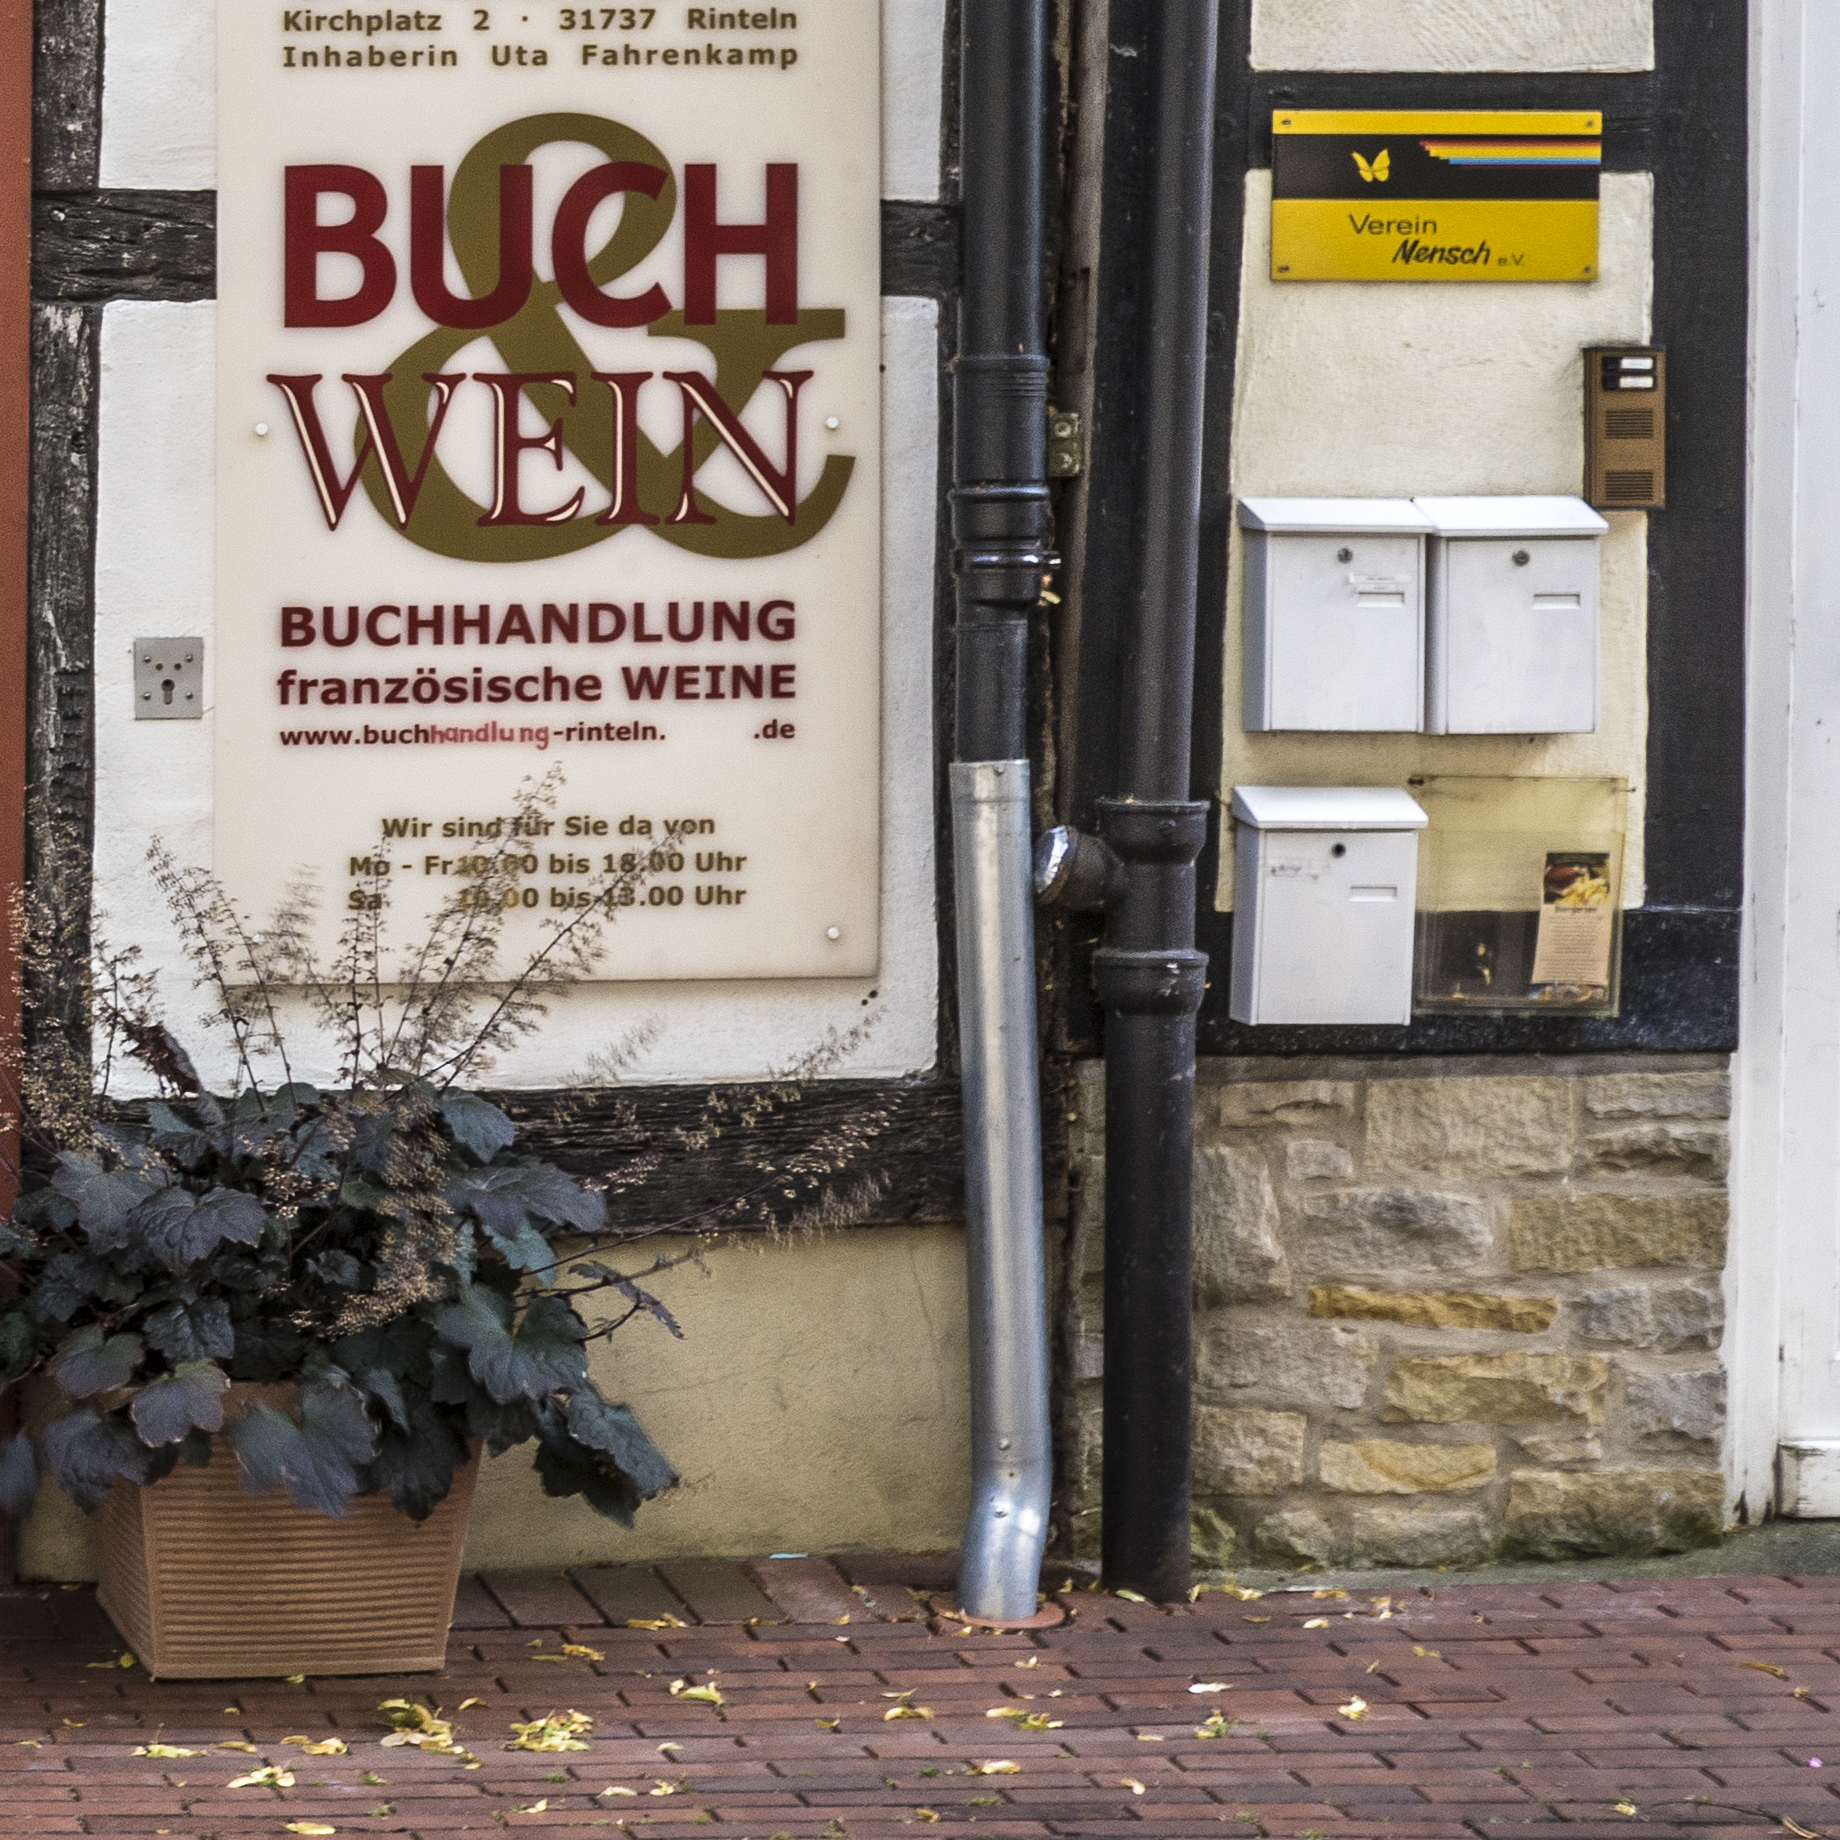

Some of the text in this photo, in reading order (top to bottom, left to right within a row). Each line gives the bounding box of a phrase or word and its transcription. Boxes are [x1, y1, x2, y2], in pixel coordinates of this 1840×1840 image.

[283, 7, 798, 36] Kirchplatz 2 31737 Rinteln
[283, 43, 798, 70] Inhaberin Uta Fahrenkamp
[1348, 214, 1437, 236] Verein
[284, 163, 799, 329] BUCH
[1391, 240, 1491, 266] Mensch
[266, 370, 814, 531] WEIN
[281, 600, 796, 647] BUCHHANDLUNG
[277, 664, 797, 705] französische WEINE
[381, 815, 716, 838] Wir sind für Sie da von
[349, 856, 391, 877] Mo
[424, 855, 453, 876] Fr
[549, 853, 590, 875] bis
[695, 851, 747, 872] Uhr
[348, 889, 383, 910] Sa
[459, 887, 539, 909] 1000
[550, 887, 590, 908] bis
[695, 885, 746, 907] Uhr
